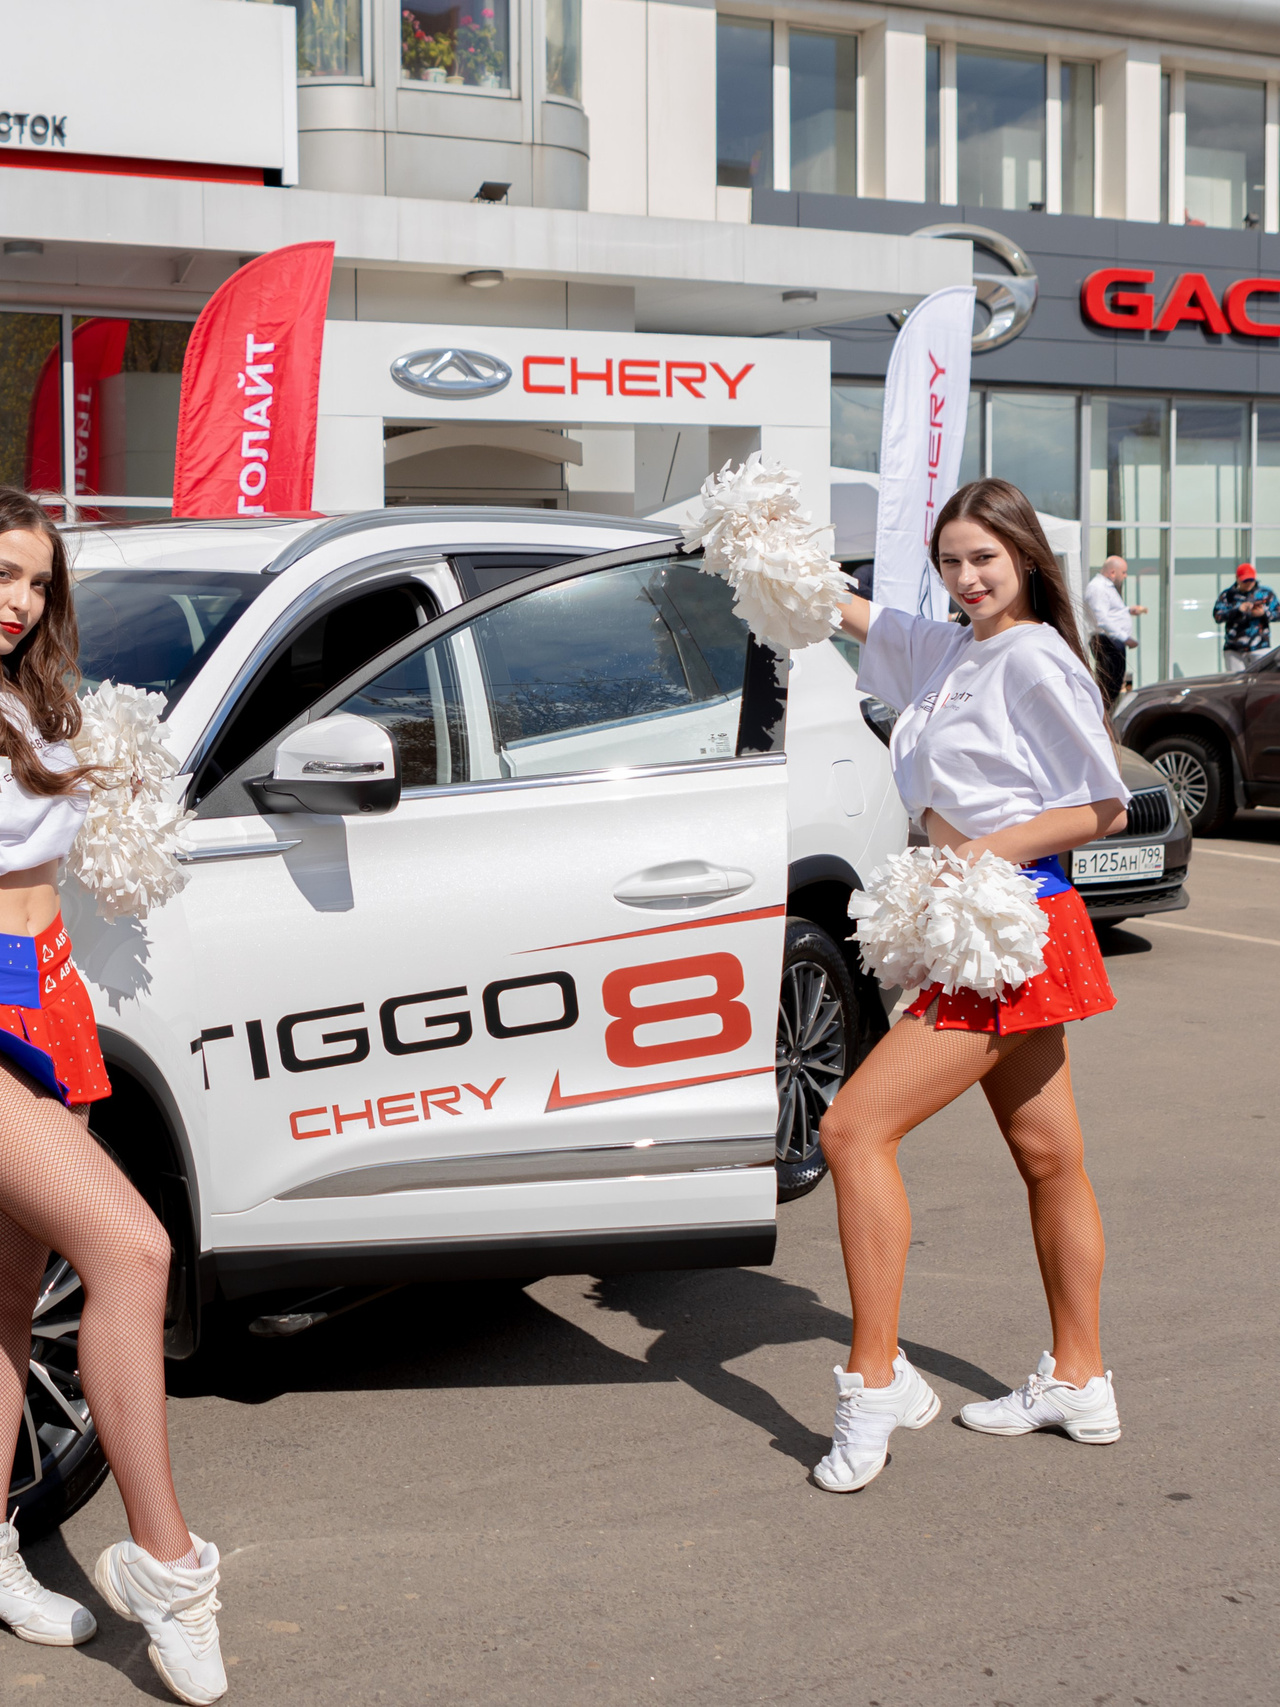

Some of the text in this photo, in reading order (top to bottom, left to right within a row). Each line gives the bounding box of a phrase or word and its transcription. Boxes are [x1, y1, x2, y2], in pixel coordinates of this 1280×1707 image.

[1082, 267, 1280, 338] GAC
[522, 355, 756, 400] CHERY
[1078, 848, 1160, 874] В125АН 799
[189, 951, 753, 1091] TIGGO 8
[288, 1076, 507, 1140] CHERY
